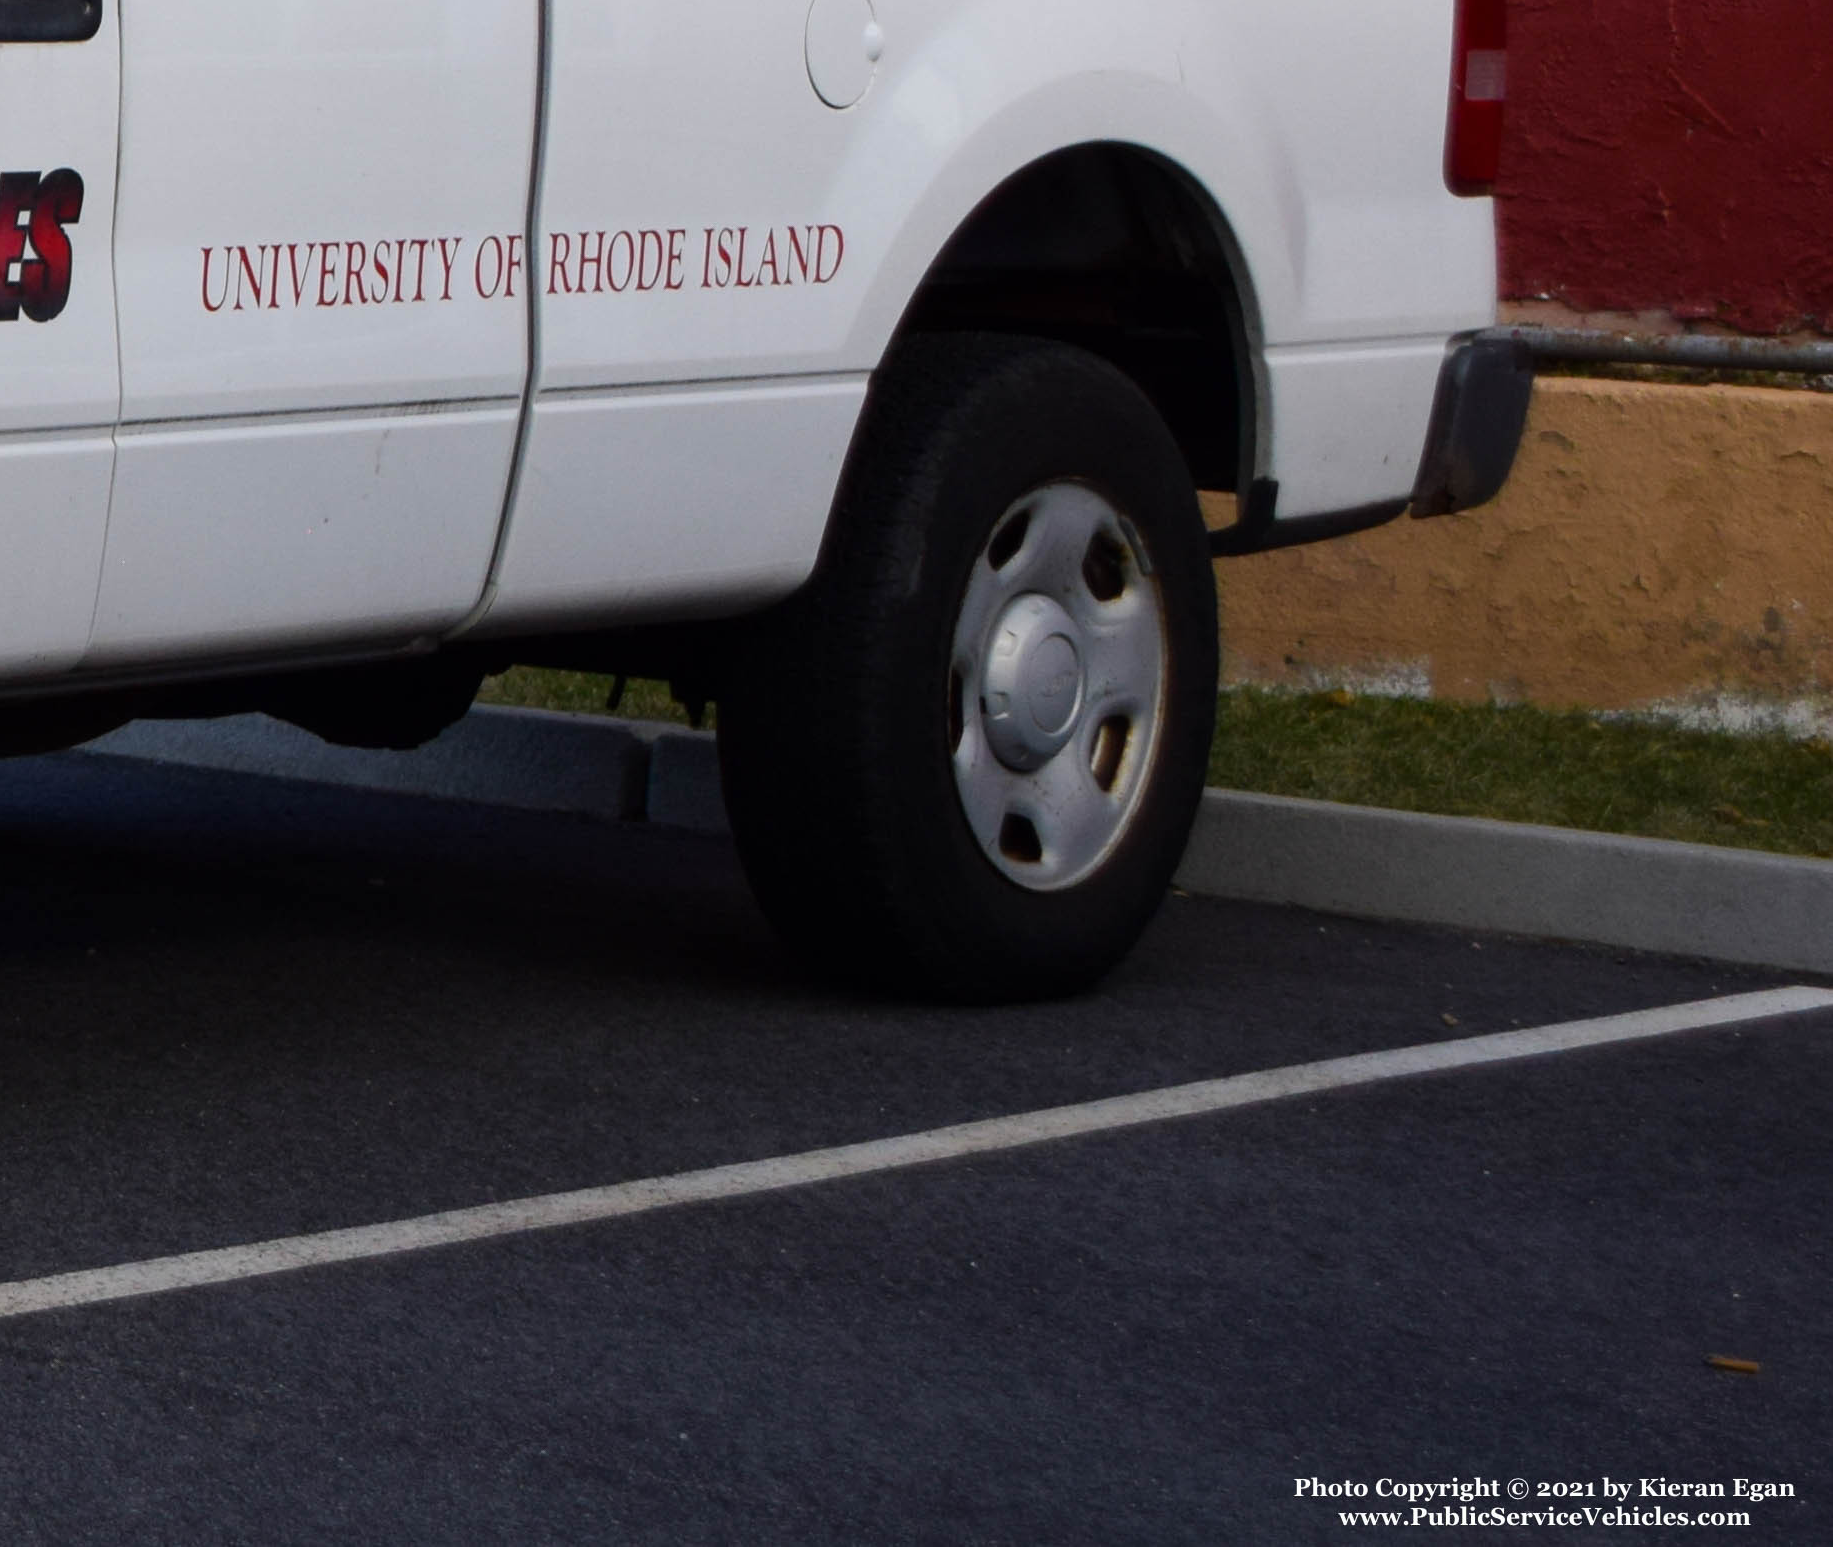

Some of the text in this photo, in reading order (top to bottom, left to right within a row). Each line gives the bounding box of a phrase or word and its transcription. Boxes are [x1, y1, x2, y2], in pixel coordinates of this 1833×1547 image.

[201, 225, 845, 311] UNIVERSITY OF RHODE ISLAND
